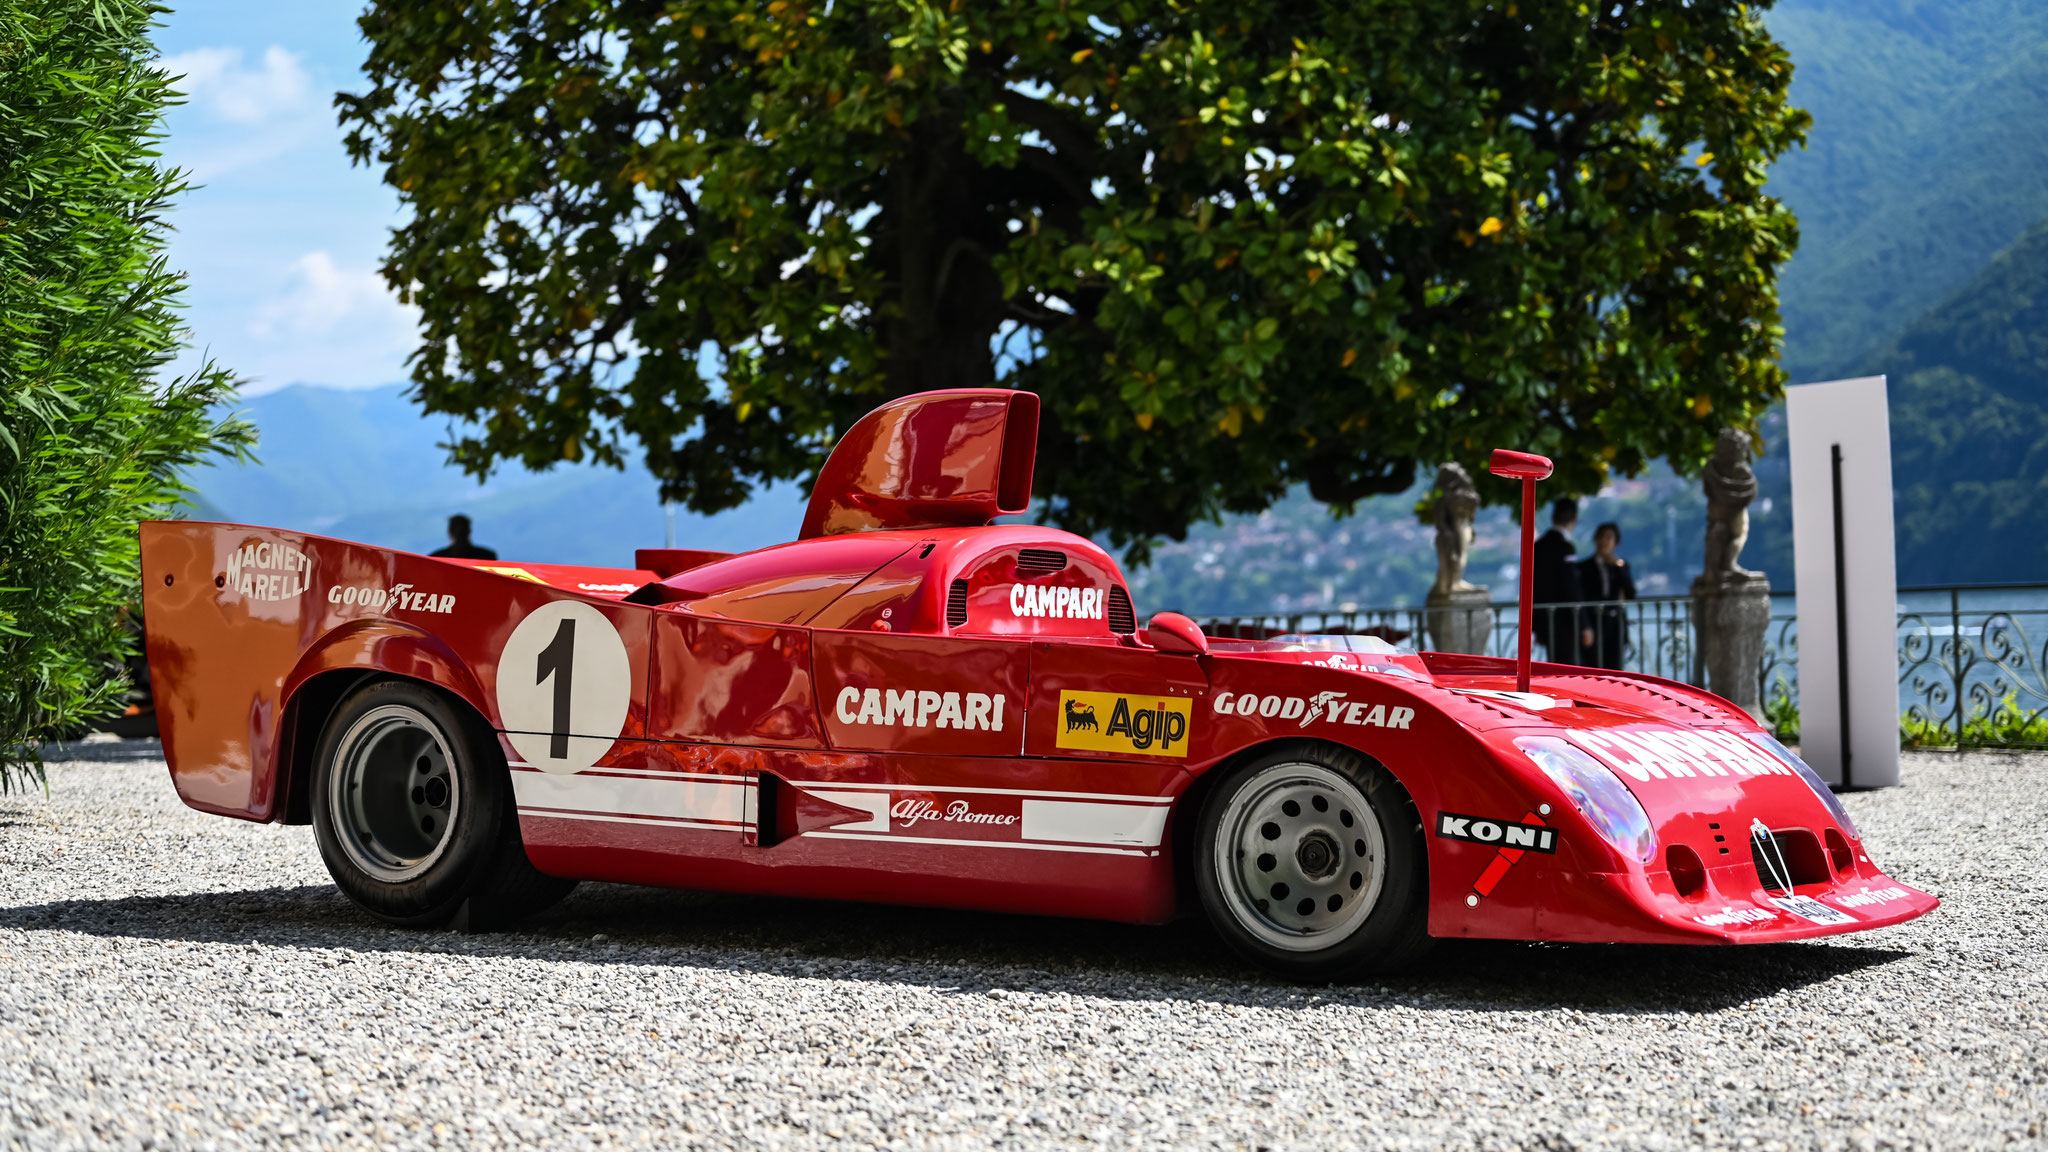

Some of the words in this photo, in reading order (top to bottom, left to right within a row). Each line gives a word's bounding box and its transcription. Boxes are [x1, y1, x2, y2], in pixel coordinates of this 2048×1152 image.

[226, 542, 312, 589] MAGNETI
[226, 555, 312, 601] MARELLI
[1010, 583, 1104, 620] CAMPARI
[536, 618, 576, 760] 1
[836, 686, 1006, 732] CAMPARI
[1105, 698, 1186, 750] Agip
[1565, 729, 1793, 782] CAMPARI
[890, 799, 943, 828] Alfa
[944, 800, 1020, 825] Romeo
[1441, 816, 1553, 850] KONI
